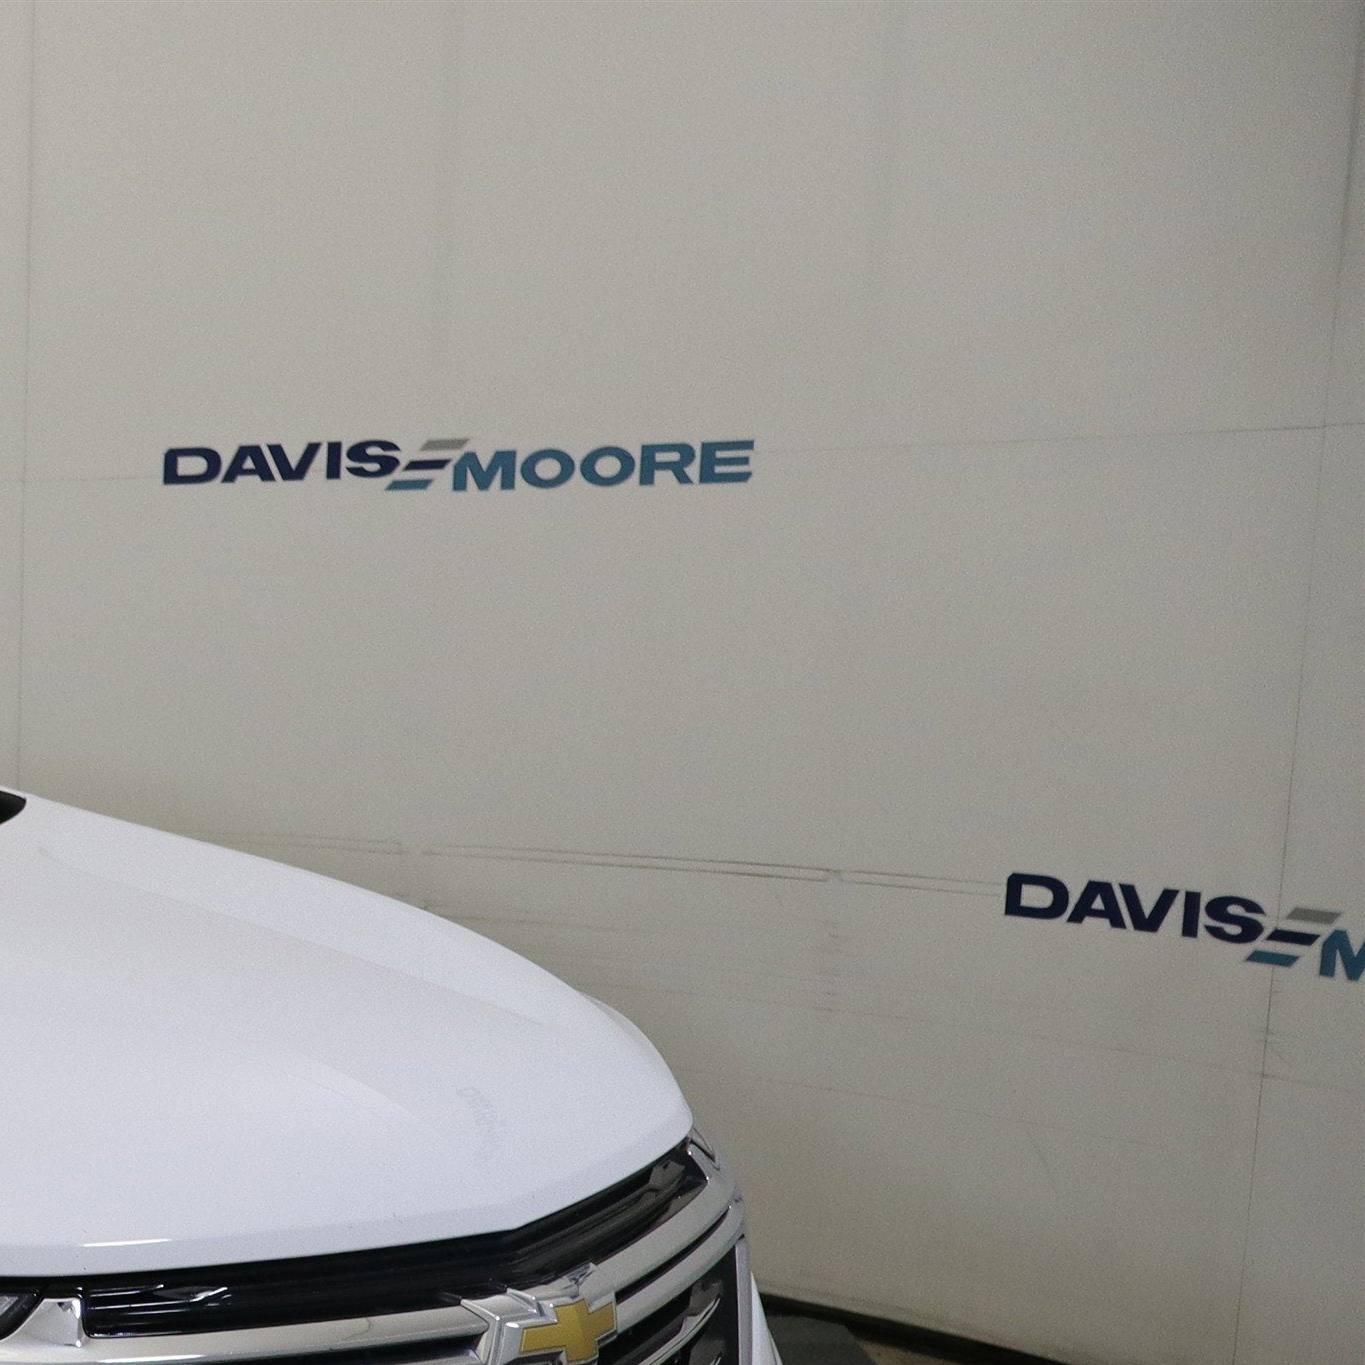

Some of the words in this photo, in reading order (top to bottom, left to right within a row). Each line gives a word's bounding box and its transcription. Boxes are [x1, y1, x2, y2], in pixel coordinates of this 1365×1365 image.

[163, 439, 402, 485] DAVIS
[452, 438, 755, 491] MOORE
[1004, 872, 1267, 944] DAVIS
